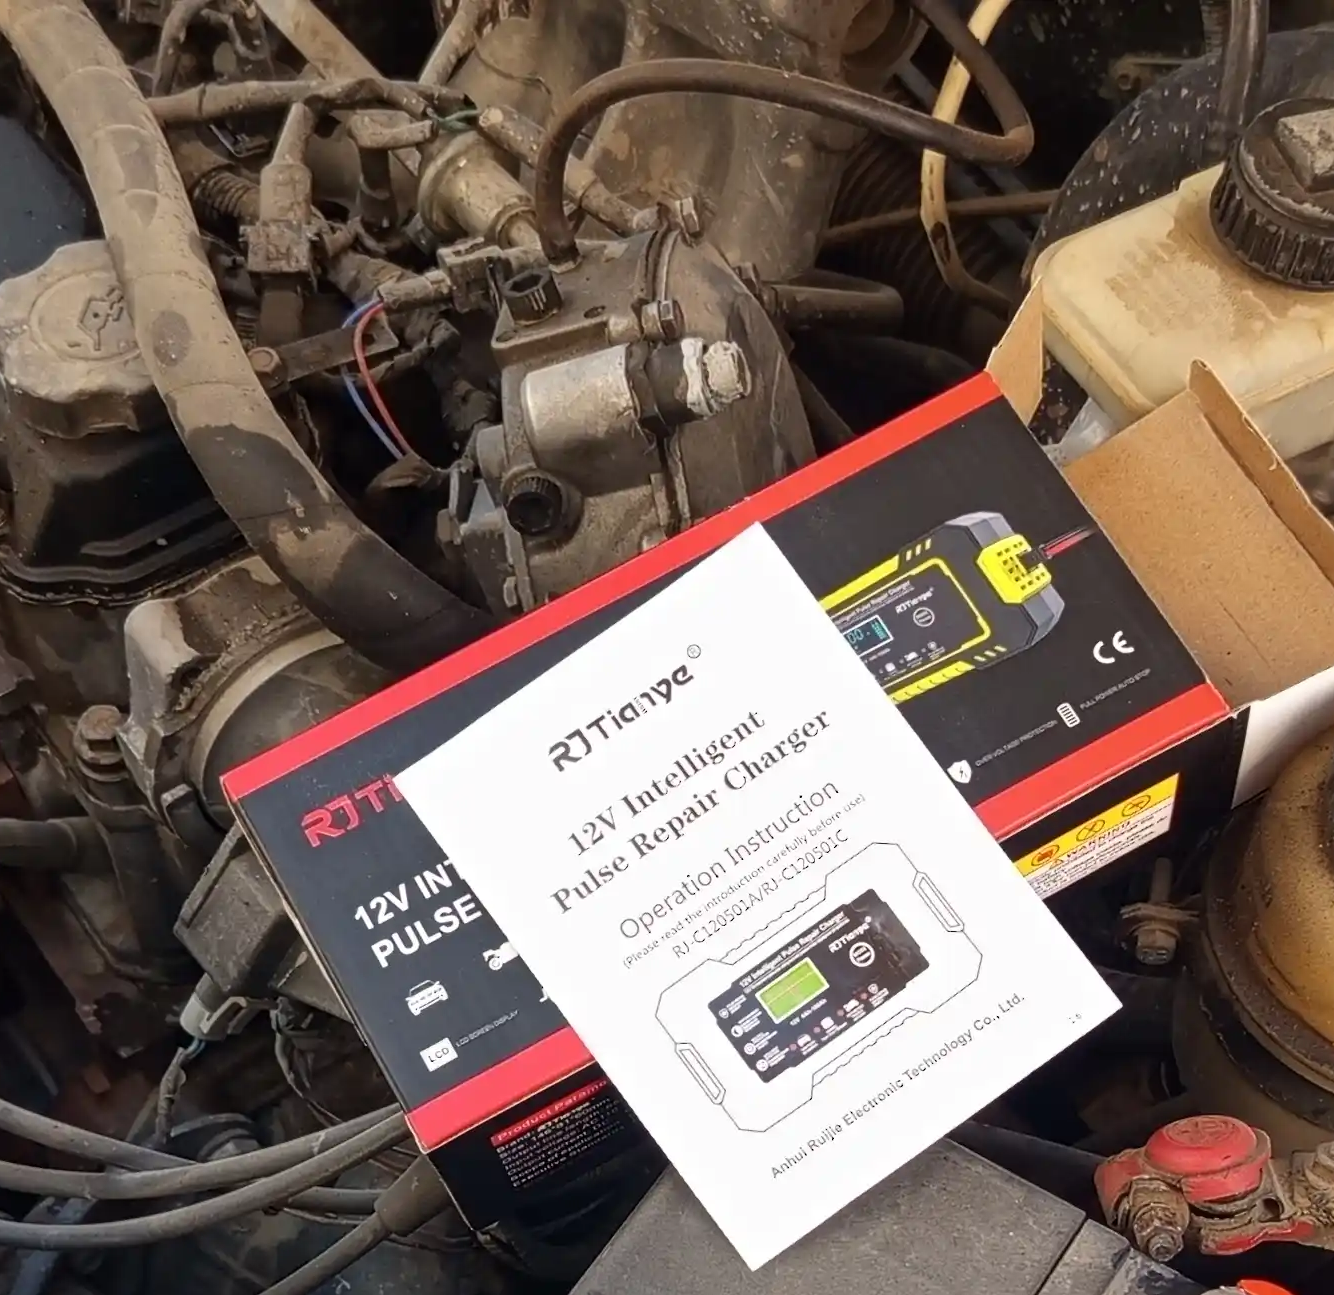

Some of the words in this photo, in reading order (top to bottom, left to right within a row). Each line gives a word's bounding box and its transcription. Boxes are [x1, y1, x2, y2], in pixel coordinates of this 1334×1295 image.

[1093, 631, 1134, 664] CE
[550, 856, 629, 914] Pulse
[628, 790, 719, 859] Repair
[724, 712, 829, 790] Charger
[569, 806, 616, 855] 12V
[621, 712, 765, 818] Intelligent
[355, 883, 408, 929] 12V
[620, 862, 726, 938] Operation
[724, 783, 839, 866] Instruction
[621, 938, 661, 970] (Please
[659, 919, 685, 942] read
[683, 907, 704, 926] the
[704, 866, 765, 911] introduction
[767, 835, 807, 866] carefully
[807, 809, 843, 838] before
[841, 792, 867, 814] use)
[672, 829, 848, 958] RJ-C120501A/RJ-C120501C
[371, 894, 482, 968] PULSE
[426, 1045, 451, 1063] LCD
[768, 1146, 808, 1180] Anhui
[805, 1122, 844, 1153] Ruijie
[842, 1080, 903, 1126] Electronic
[902, 1029, 972, 1080] Technology
[969, 1006, 1001, 1035] Co.,
[997, 990, 1025, 1014] Ltd.
[496, 1107, 552, 1142] Product
